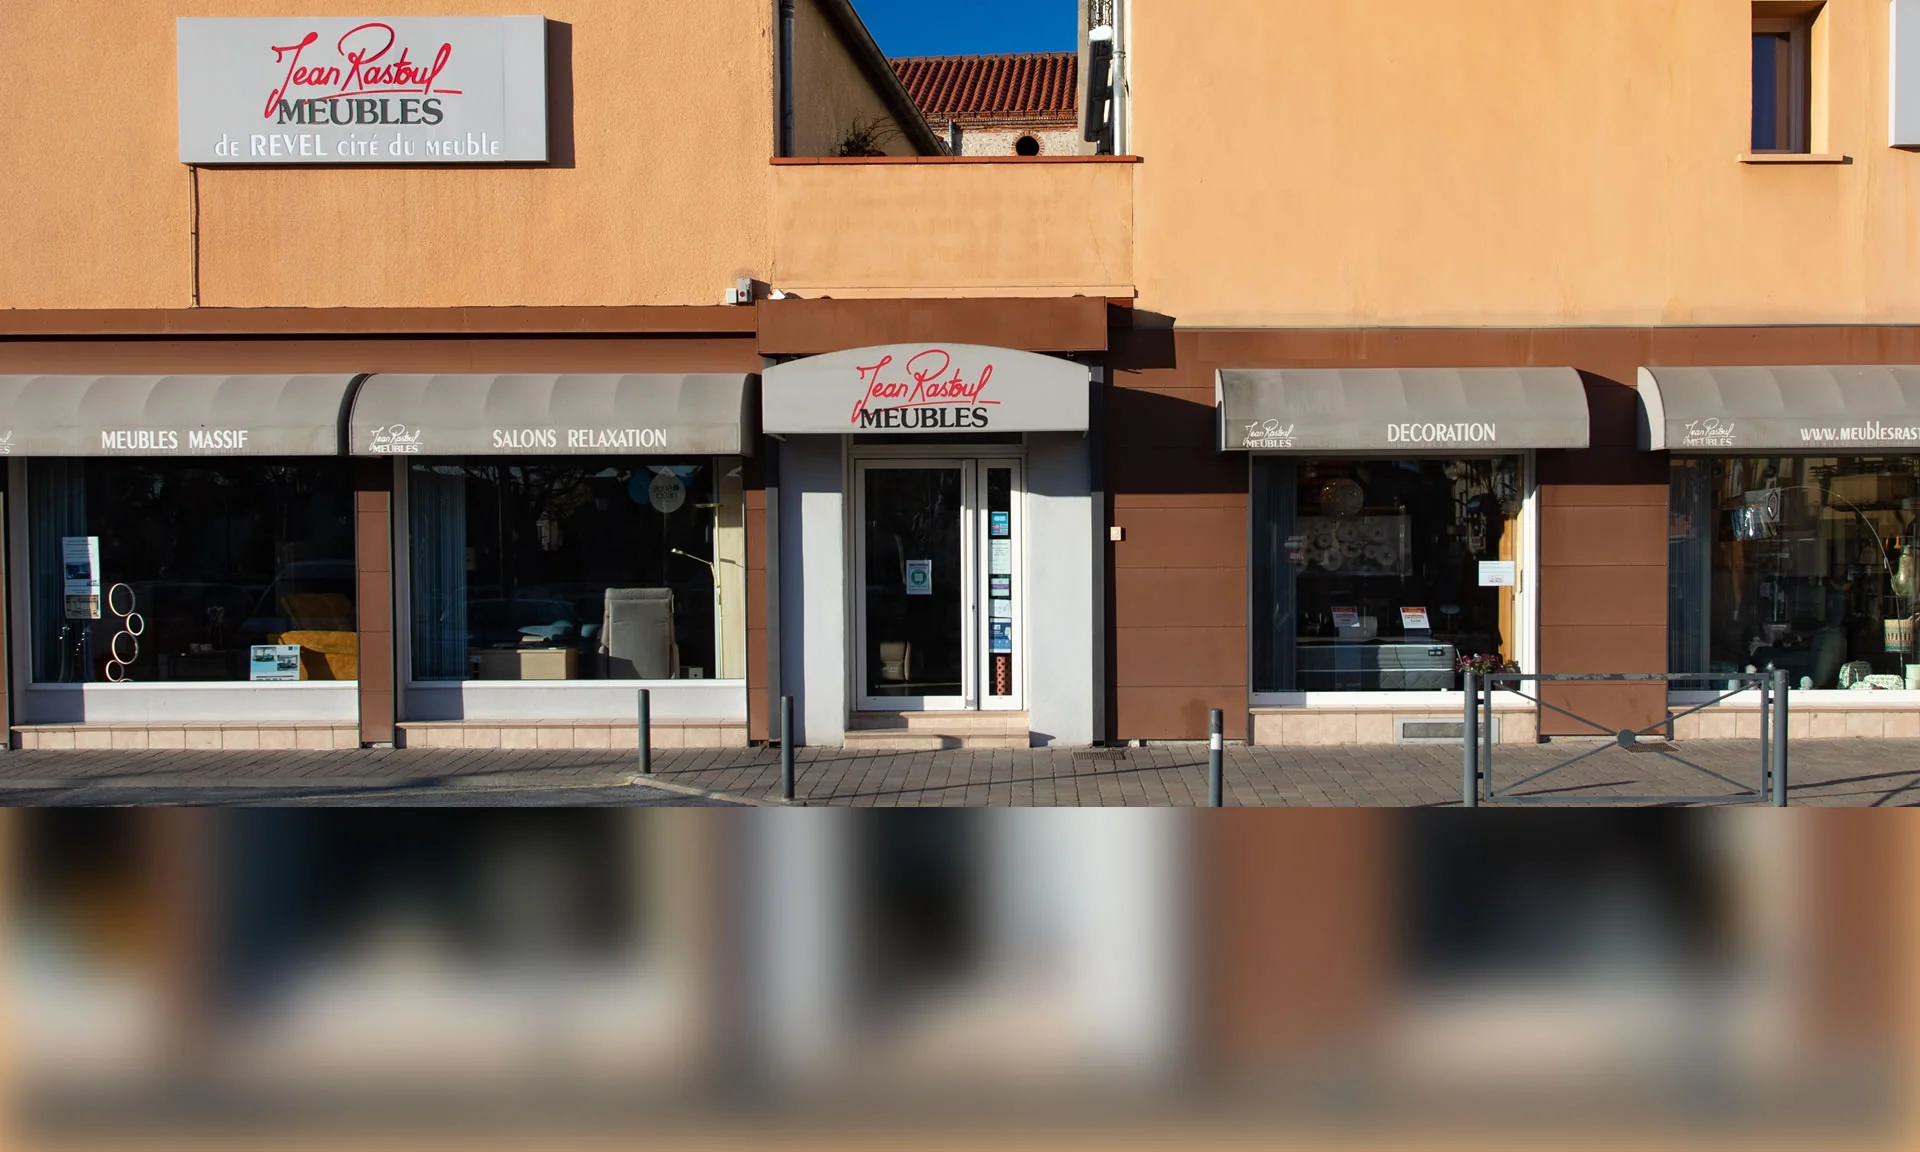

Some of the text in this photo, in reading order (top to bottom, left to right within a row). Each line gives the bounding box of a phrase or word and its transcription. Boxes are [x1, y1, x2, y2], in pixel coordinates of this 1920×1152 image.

[264, 22, 452, 119] Jean Rastoul
[277, 98, 444, 126] MEUBLES
[249, 134, 329, 157] REVEL
[851, 349, 993, 423] Jean Rastoul
[860, 407, 989, 429] MEUBLES
[101, 430, 249, 449] MEUBLES MASSIF
[492, 428, 667, 448] SALONS RELAXATION
[1387, 422, 1496, 442] DECORATION
[372, 444, 419, 453] MEUBLES
[1246, 439, 1292, 448] MEUBLES
[1686, 438, 1732, 447] MEUBLES
